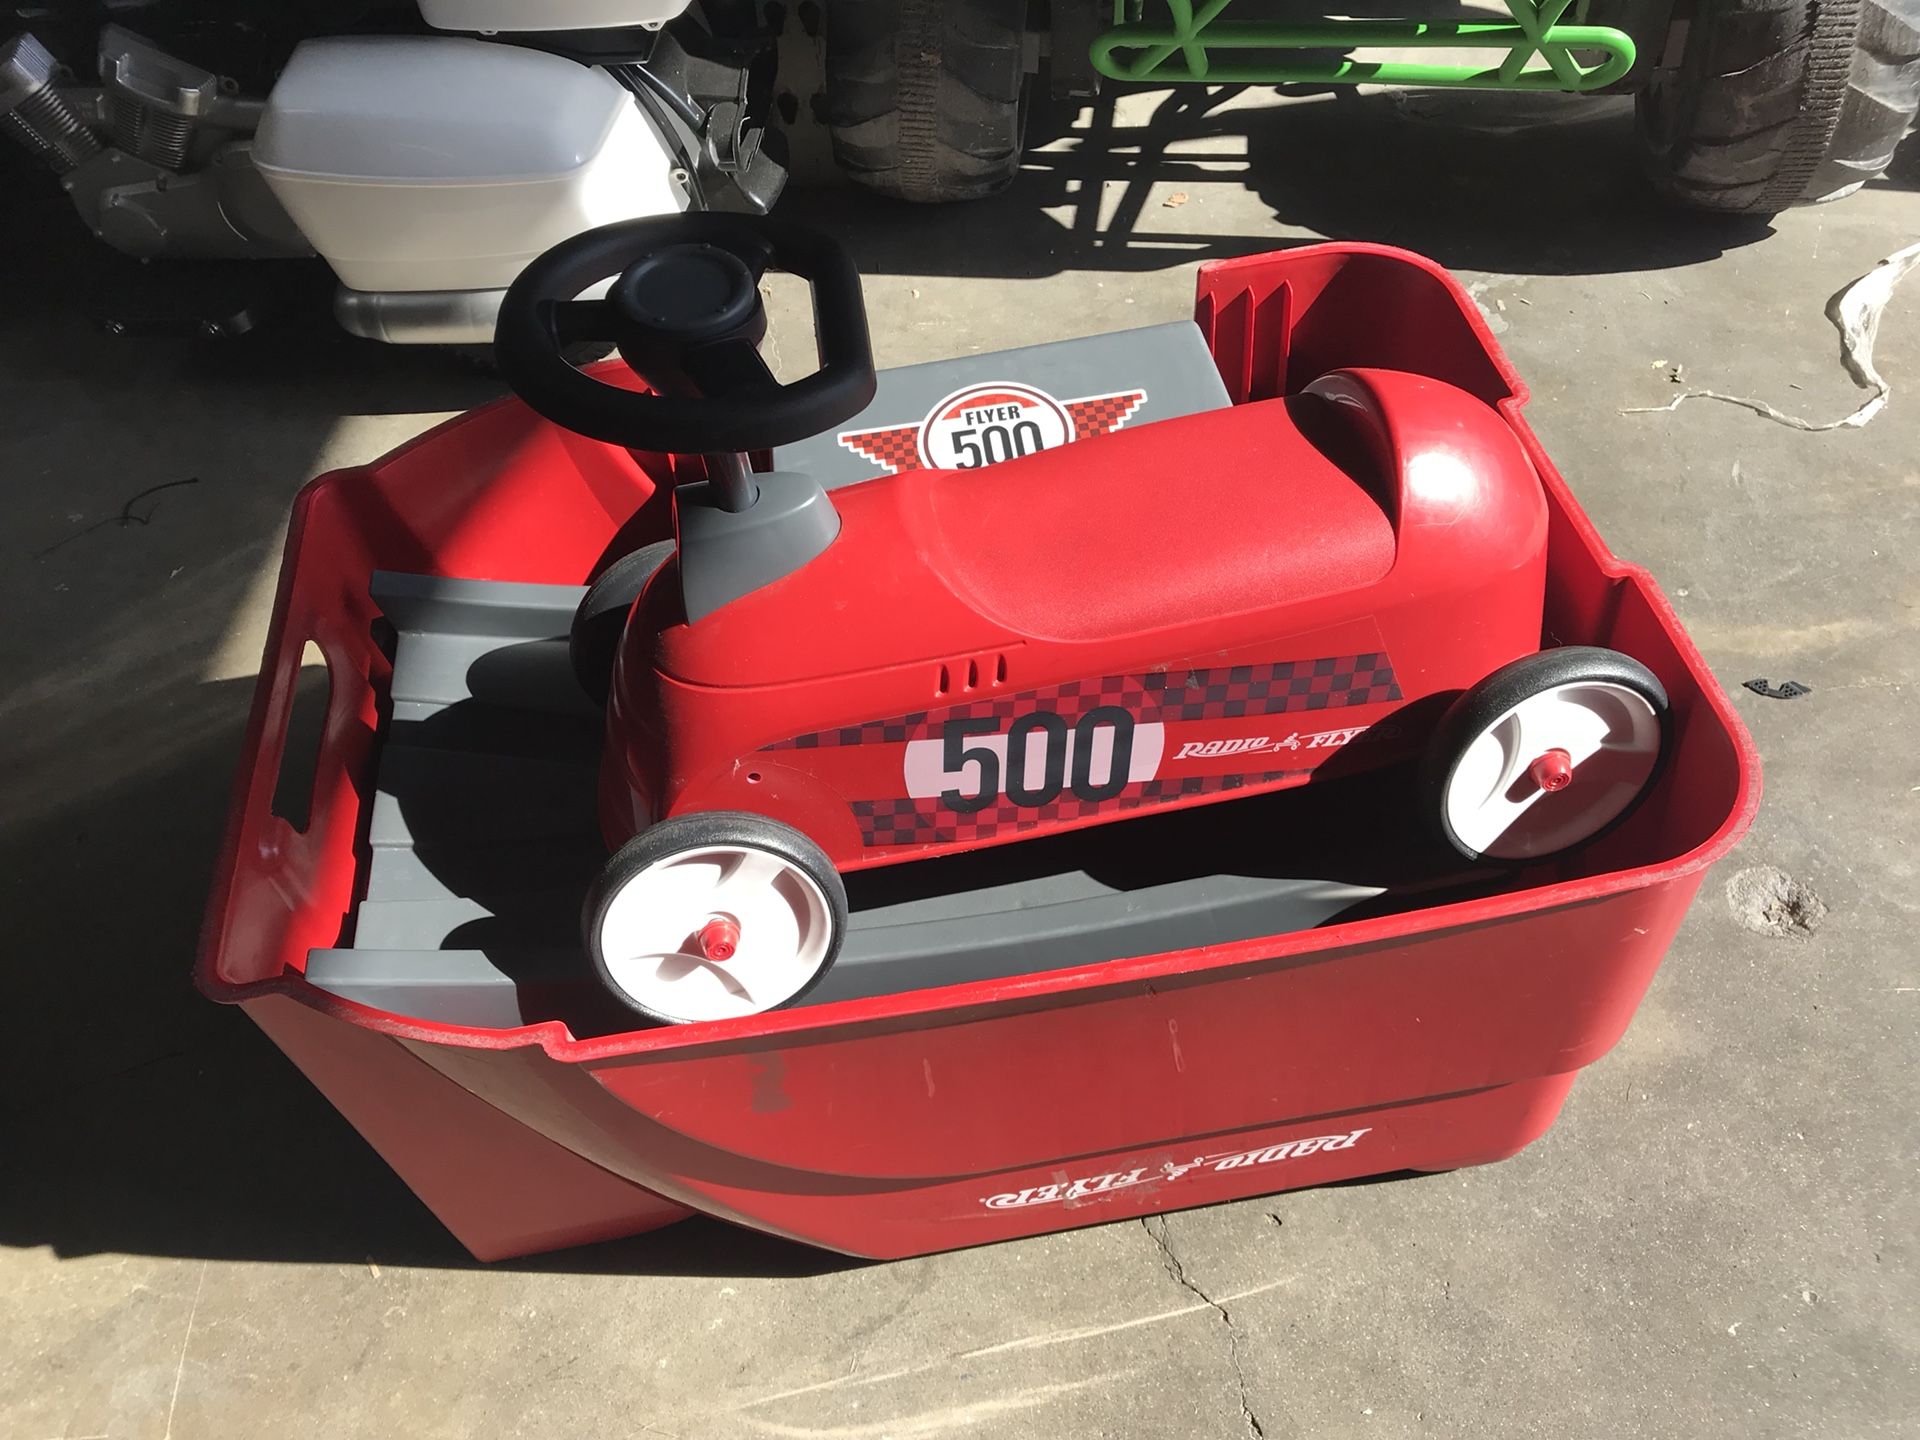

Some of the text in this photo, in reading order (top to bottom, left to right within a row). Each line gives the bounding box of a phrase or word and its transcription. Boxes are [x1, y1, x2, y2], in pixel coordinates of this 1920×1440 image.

[966, 406, 1021, 426] FLYER
[952, 421, 1044, 469] 500
[941, 706, 1135, 813] 500
[1173, 736, 1271, 760] RADIO
[983, 1128, 1373, 1209] RADIO FLYER
